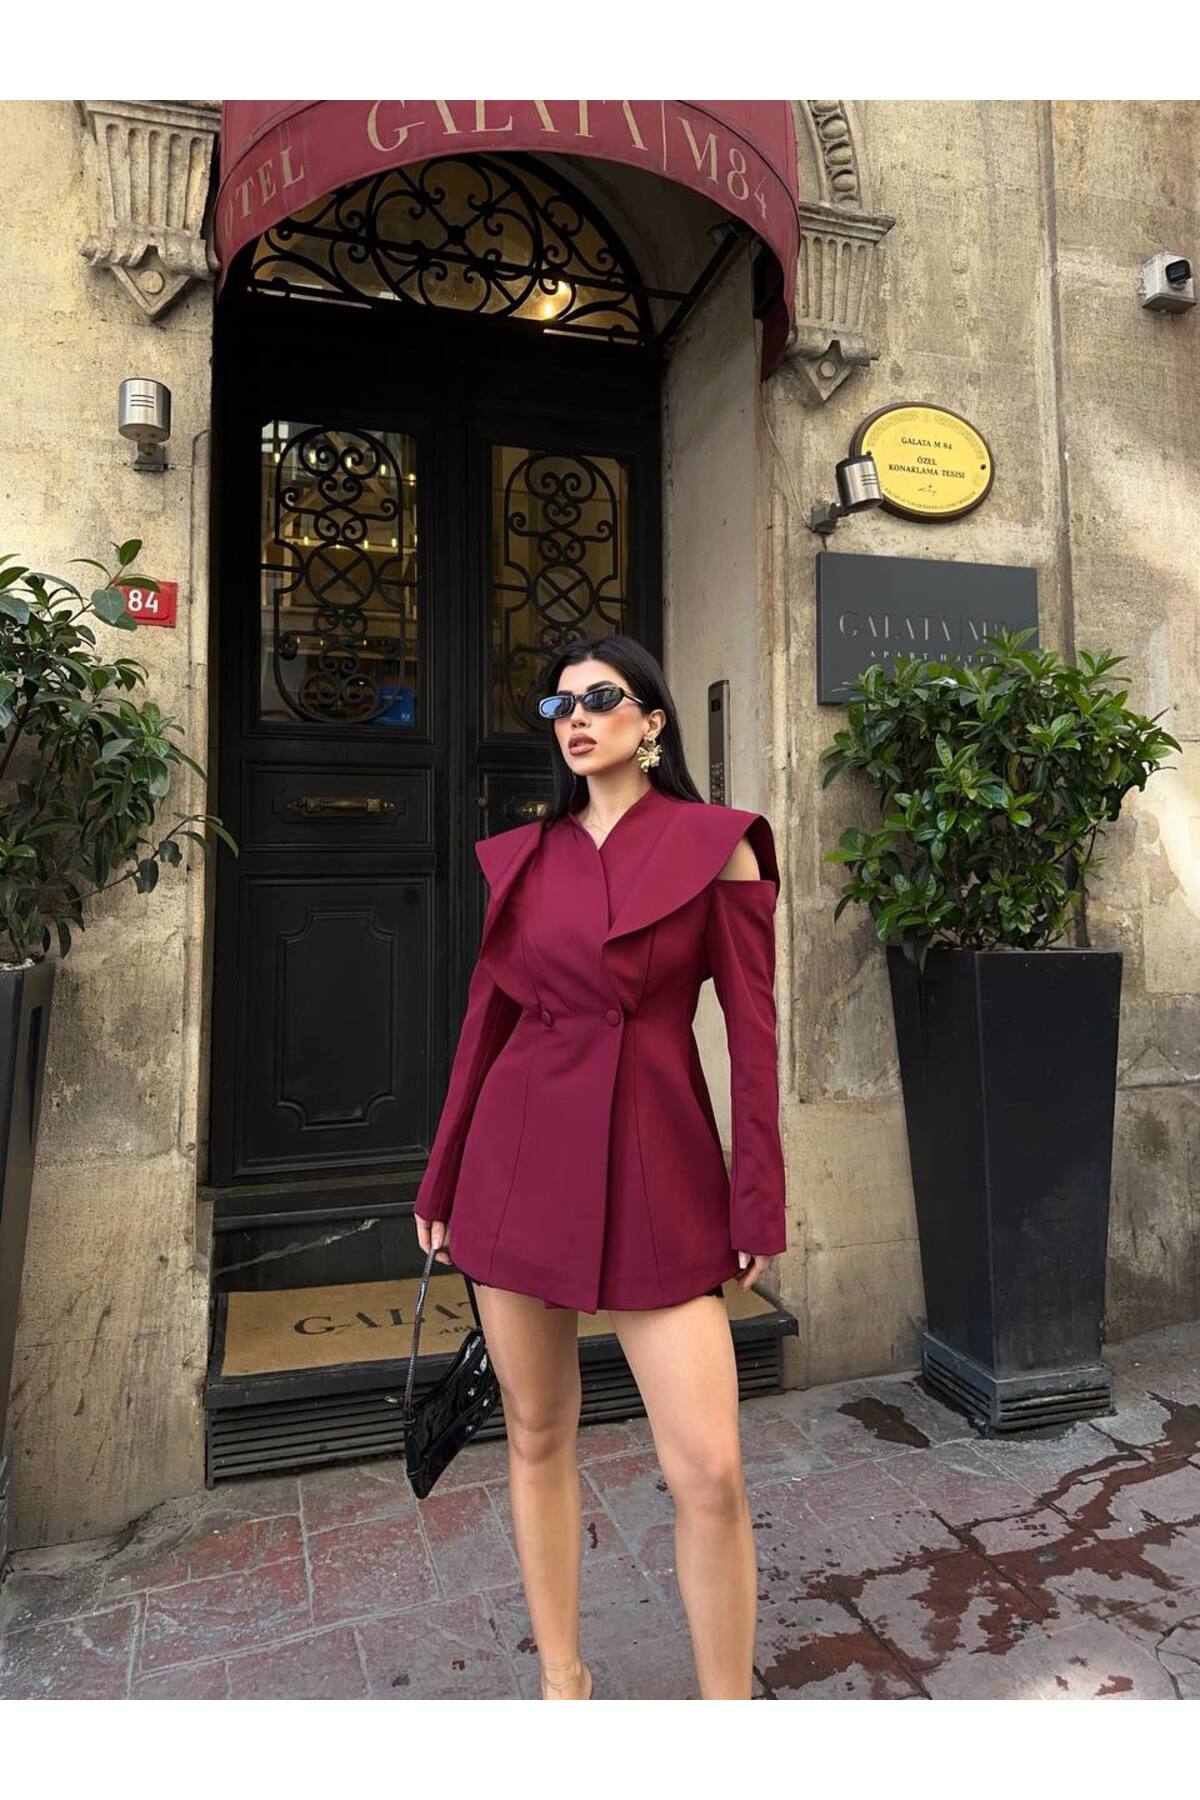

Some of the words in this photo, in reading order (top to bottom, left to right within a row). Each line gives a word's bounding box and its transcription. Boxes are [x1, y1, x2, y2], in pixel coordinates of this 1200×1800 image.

[677, 115, 768, 221] M84
[901, 436, 932, 448] GALATA
[934, 440, 941, 449] M
[888, 463, 939, 476] KONAKLAMA
[128, 589, 159, 613] 84
[294, 1301, 473, 1335] GALA
